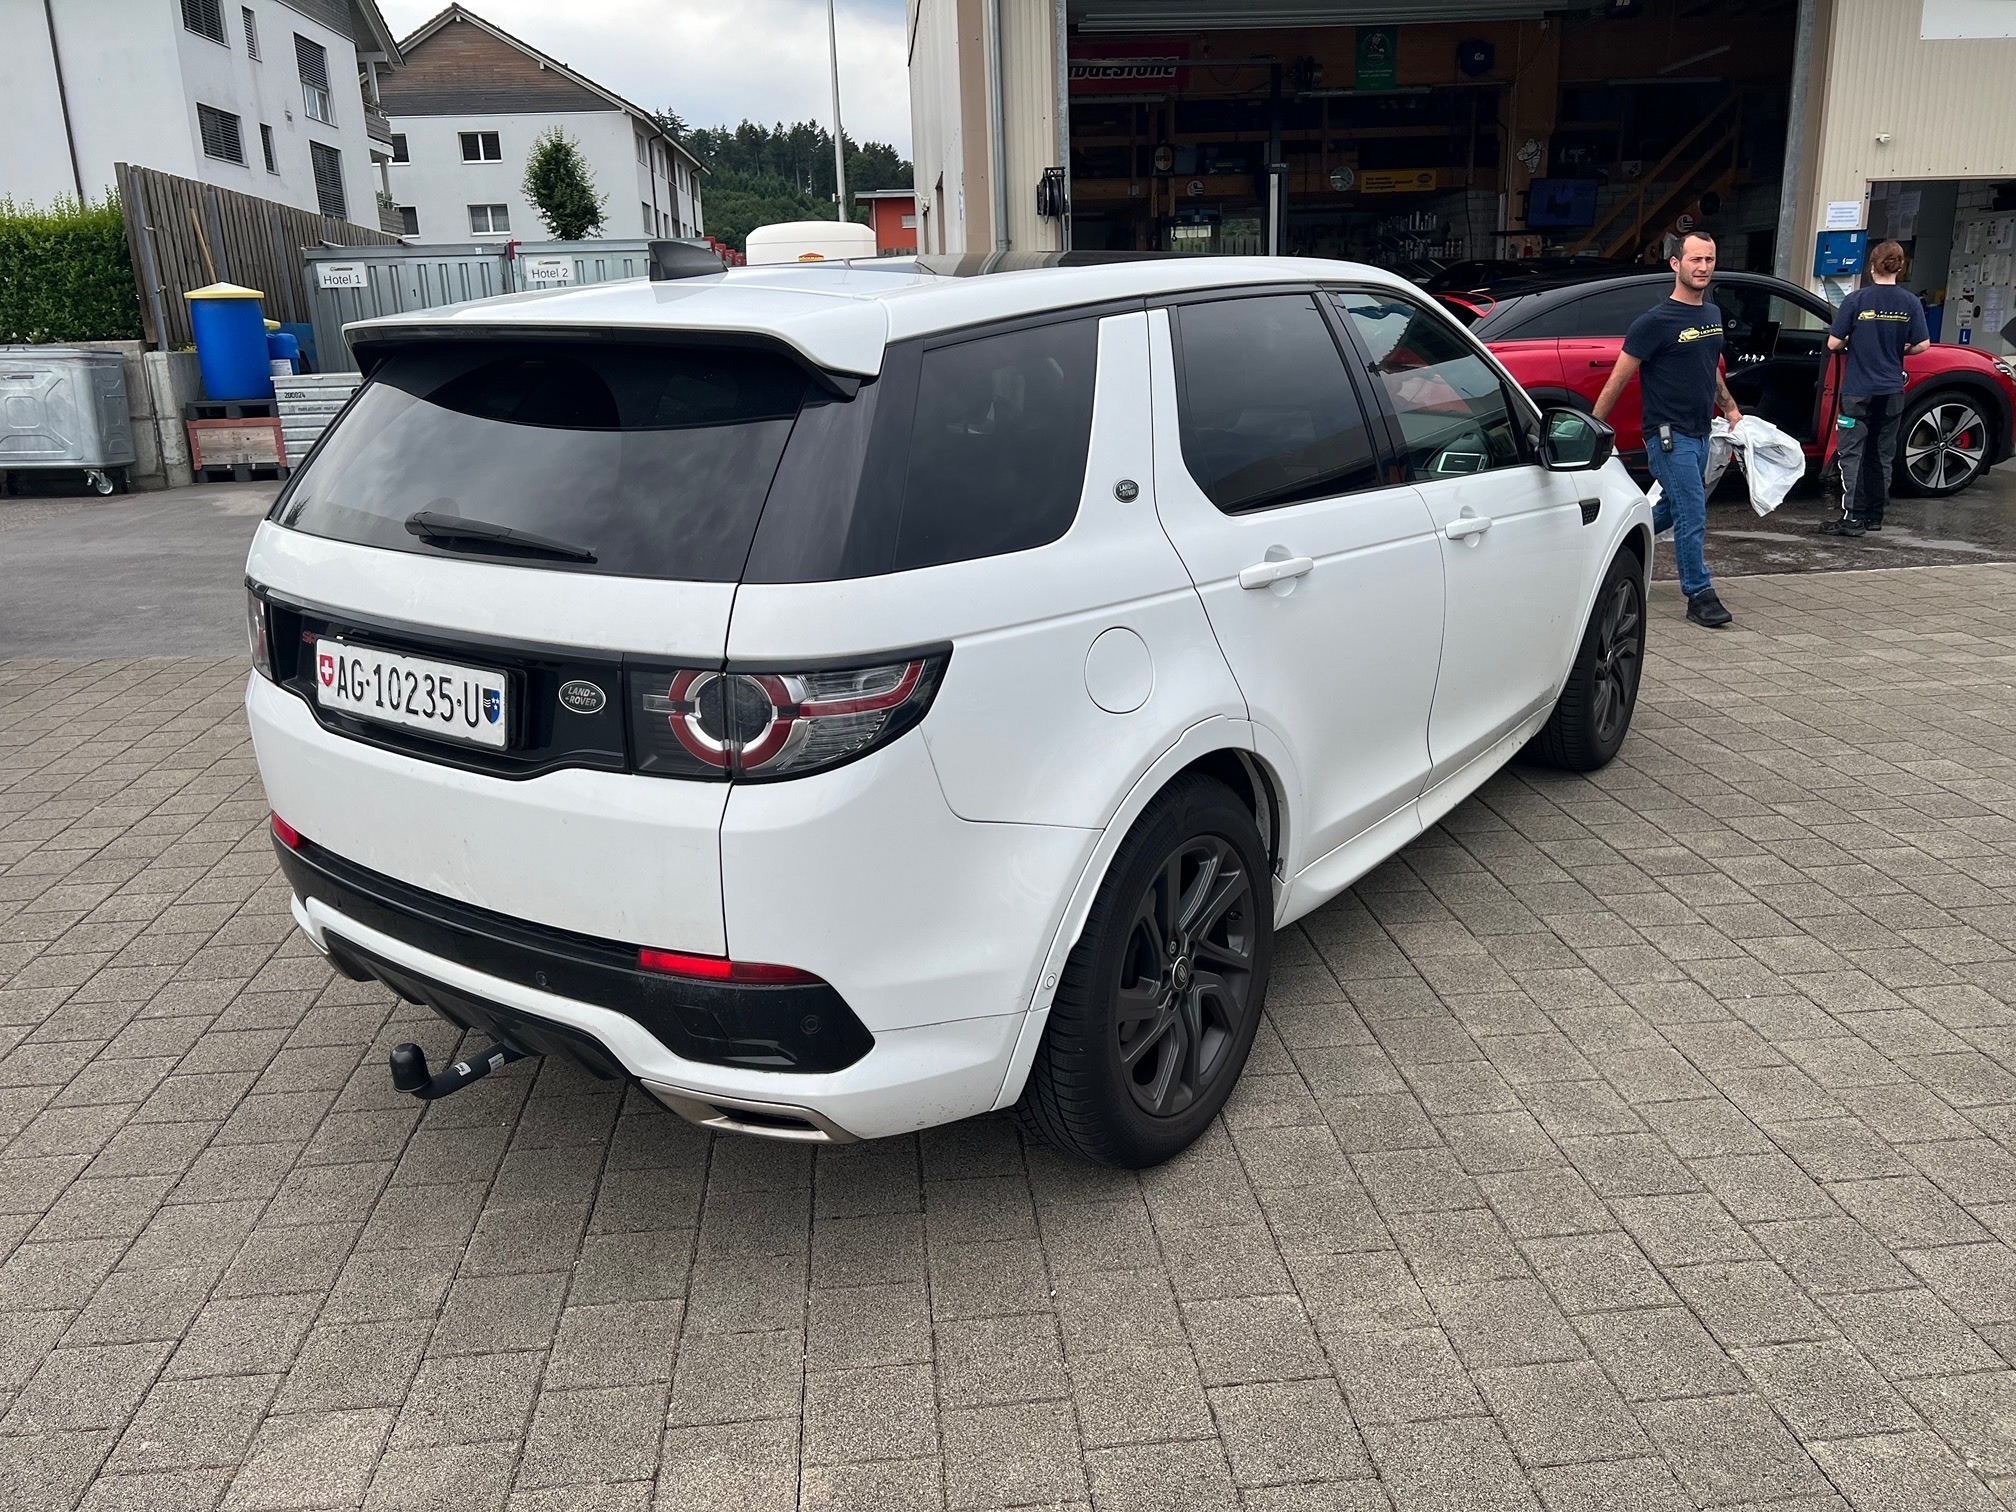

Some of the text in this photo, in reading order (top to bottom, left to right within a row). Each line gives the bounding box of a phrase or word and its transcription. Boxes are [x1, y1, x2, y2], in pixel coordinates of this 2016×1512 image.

[531, 267, 569, 279] Hotel 2
[323, 274, 361, 285] Hotel 1
